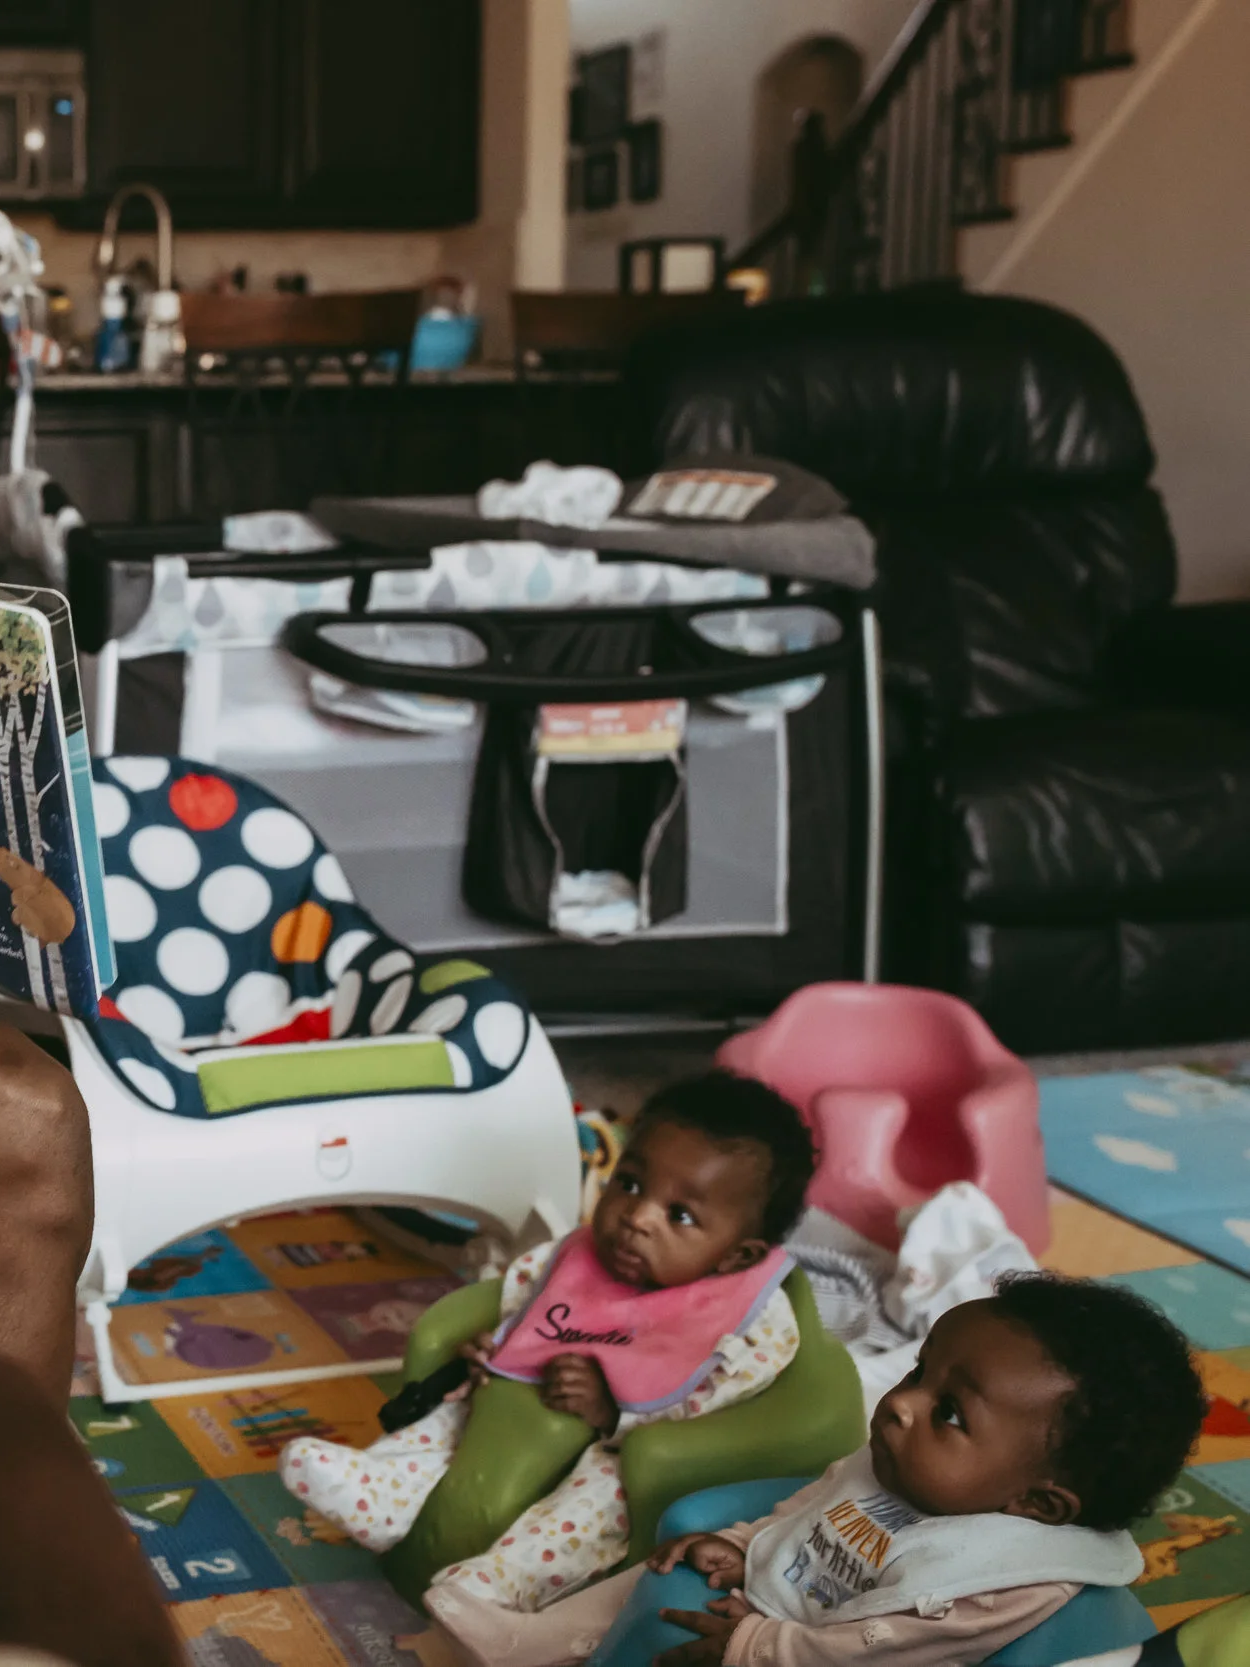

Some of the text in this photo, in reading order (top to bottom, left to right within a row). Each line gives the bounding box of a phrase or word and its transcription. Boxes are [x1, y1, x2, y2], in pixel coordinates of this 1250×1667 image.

[185, 1556, 237, 1579] 2
[806, 1521, 833, 1558] for
[828, 1544, 876, 1592] little
[823, 1499, 893, 1569] HEAVEN
